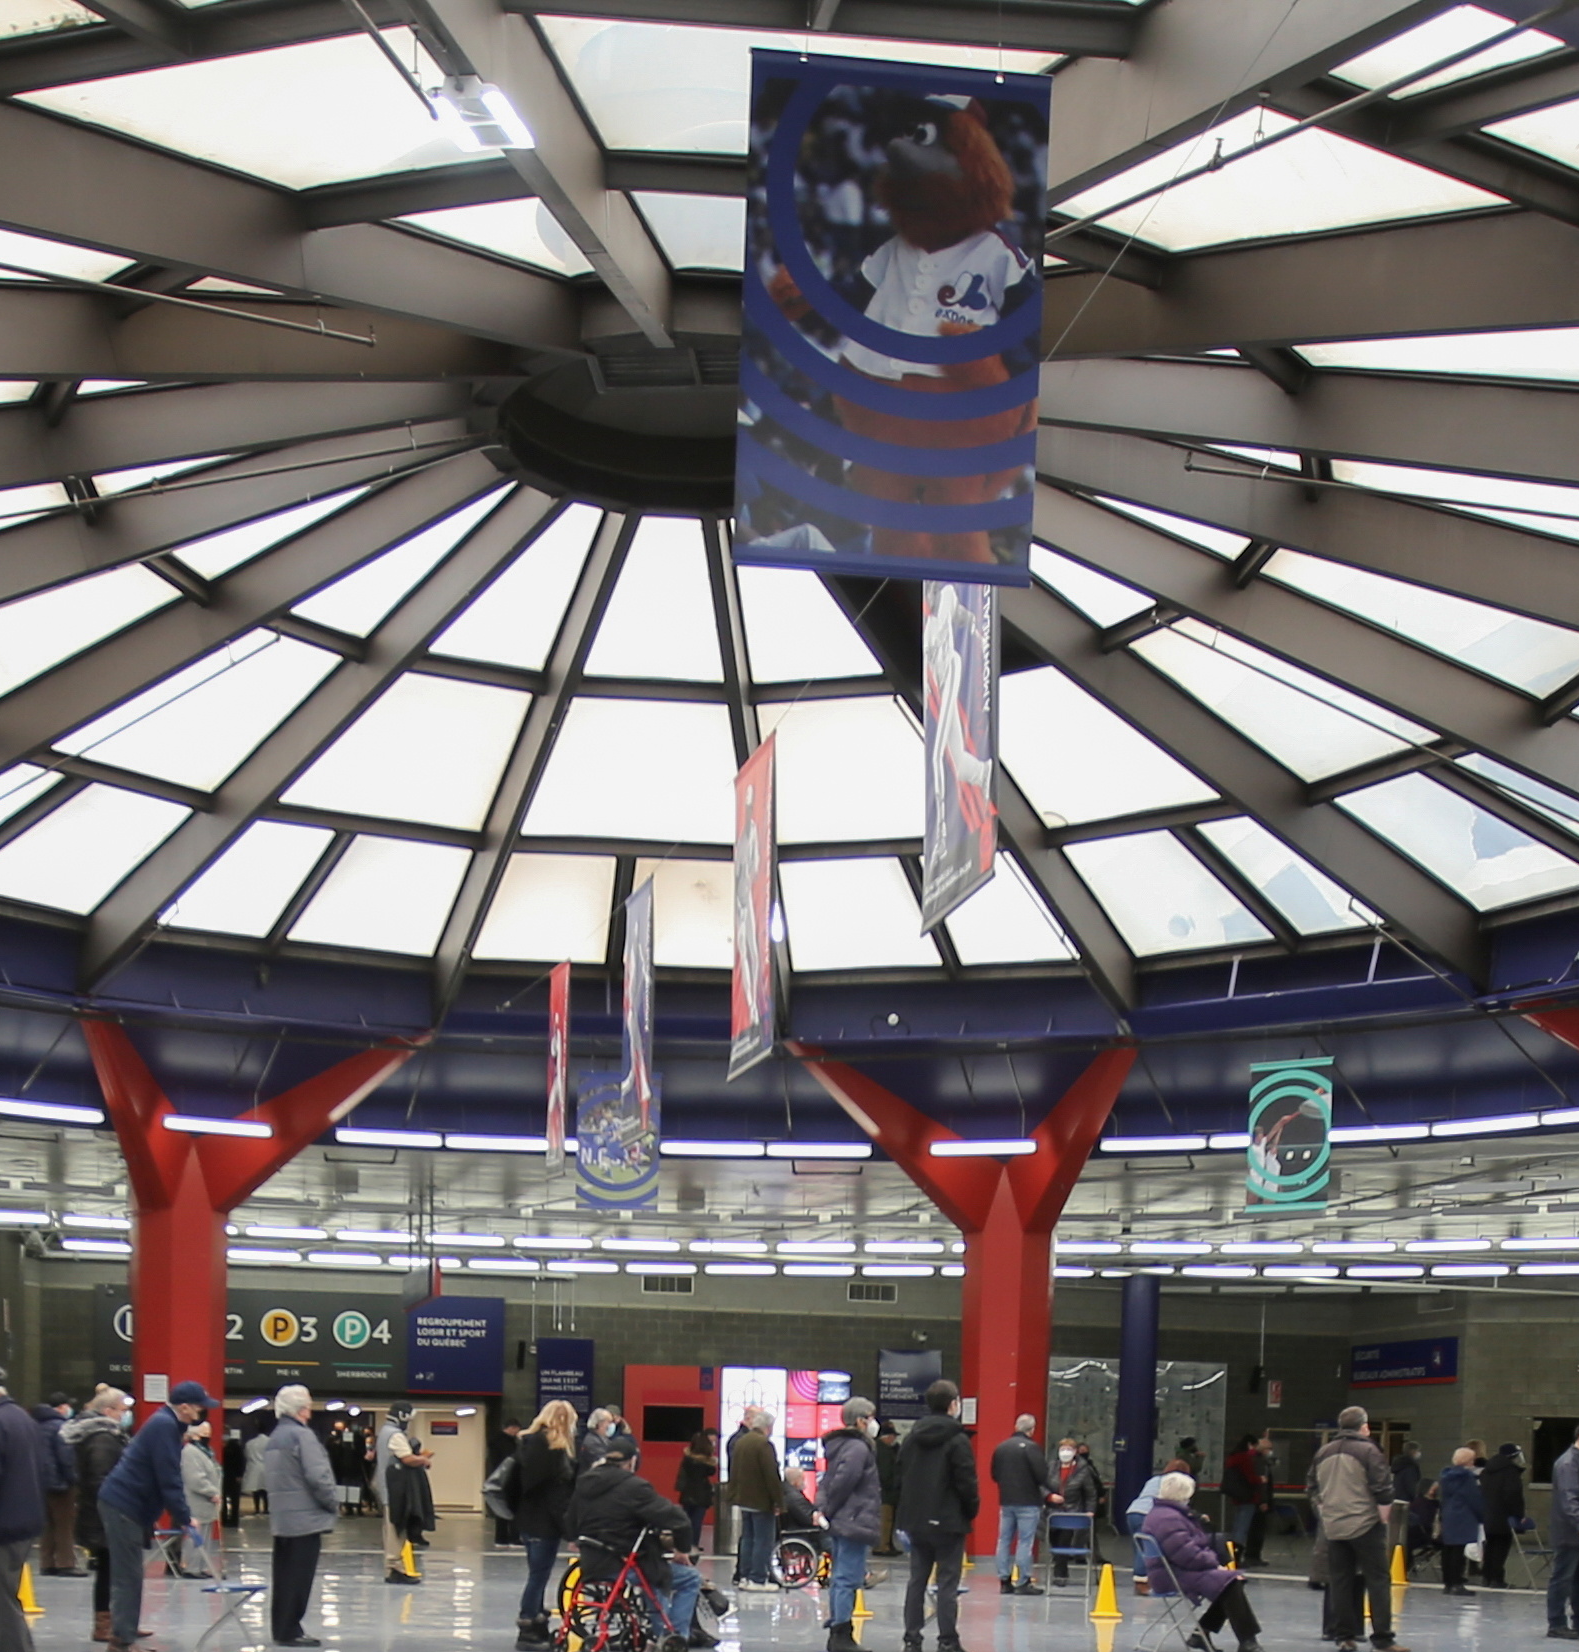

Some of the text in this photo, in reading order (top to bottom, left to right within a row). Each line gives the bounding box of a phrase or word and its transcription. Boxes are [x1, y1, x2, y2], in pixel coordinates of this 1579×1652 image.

[225, 1314, 244, 1340] 2
[416, 1317, 487, 1328] REGROUPEMENT
[416, 1328, 486, 1338] LOISIR ET SPORT
[416, 1337, 467, 1348] DU QUÉBEC
